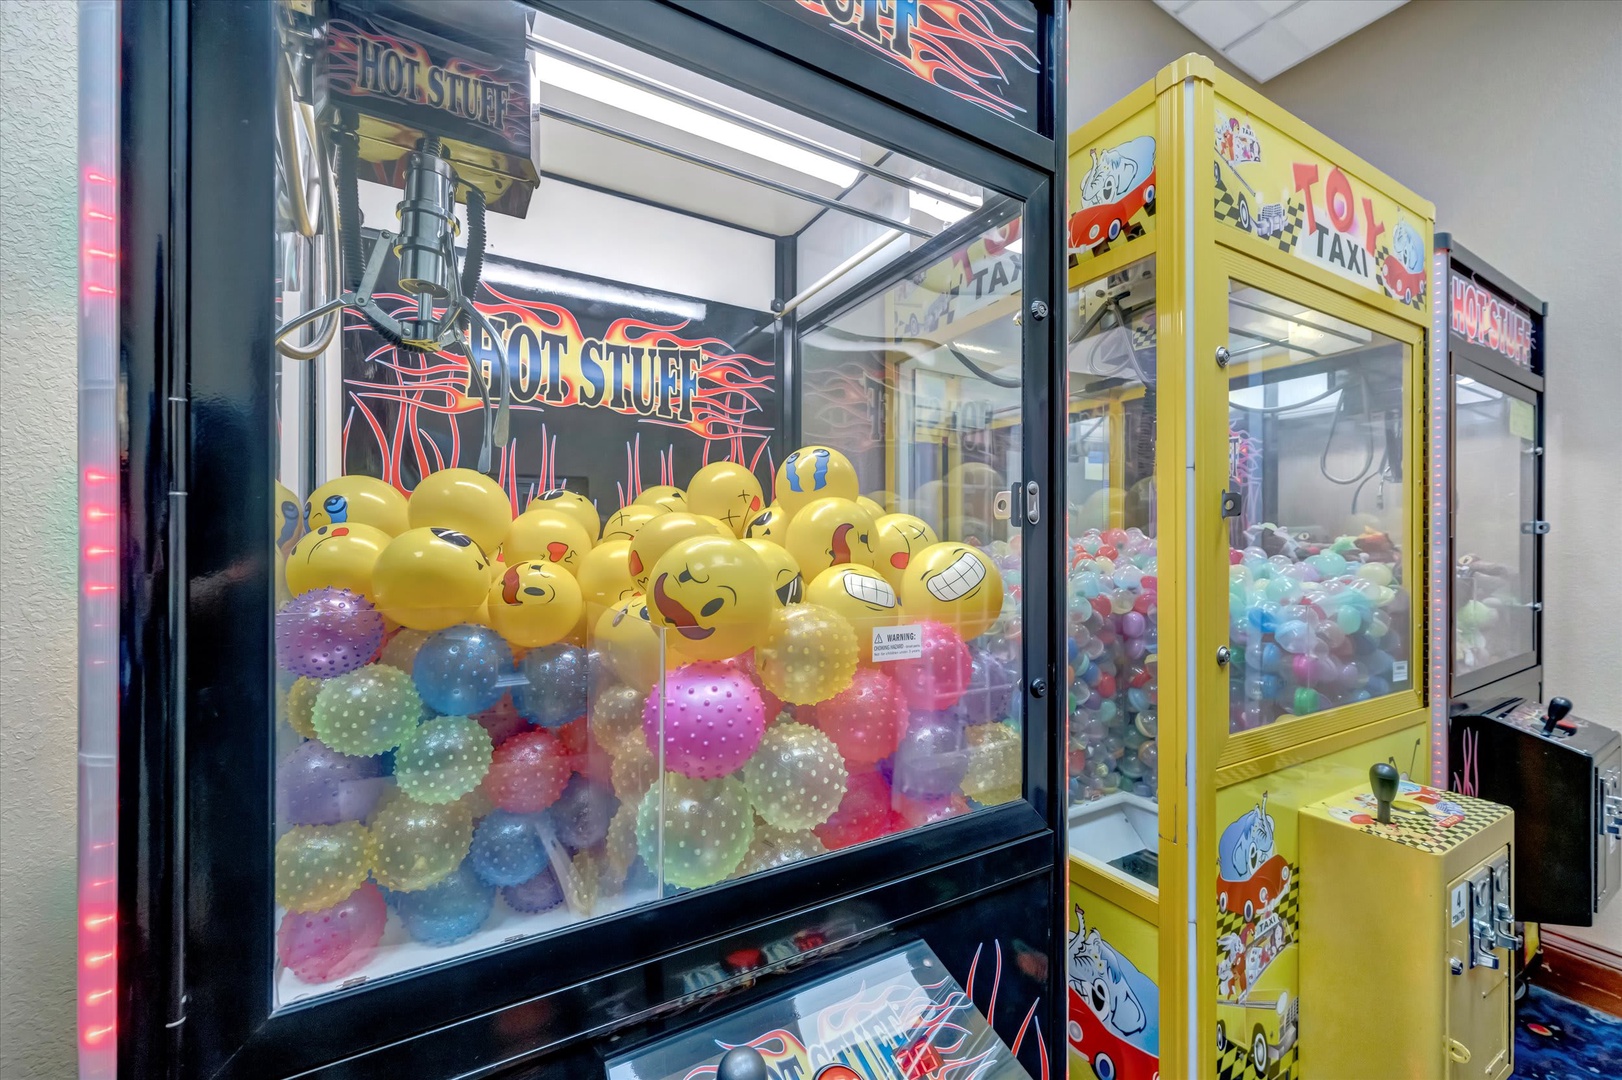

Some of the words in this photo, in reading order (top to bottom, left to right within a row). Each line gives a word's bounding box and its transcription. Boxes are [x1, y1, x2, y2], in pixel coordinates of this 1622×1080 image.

[356, 35, 420, 100] HOT
[427, 65, 510, 129] STUFF
[1292, 162, 1385, 258] TOY
[1315, 222, 1369, 278] TAXI
[1452, 275, 1487, 344] HOT
[1488, 299, 1531, 365] STUFF
[466, 315, 568, 403] HOT
[578, 337, 702, 422] STUFF
[887, 633, 916, 642] WARNING:
[1259, 915, 1276, 932] TAXI
